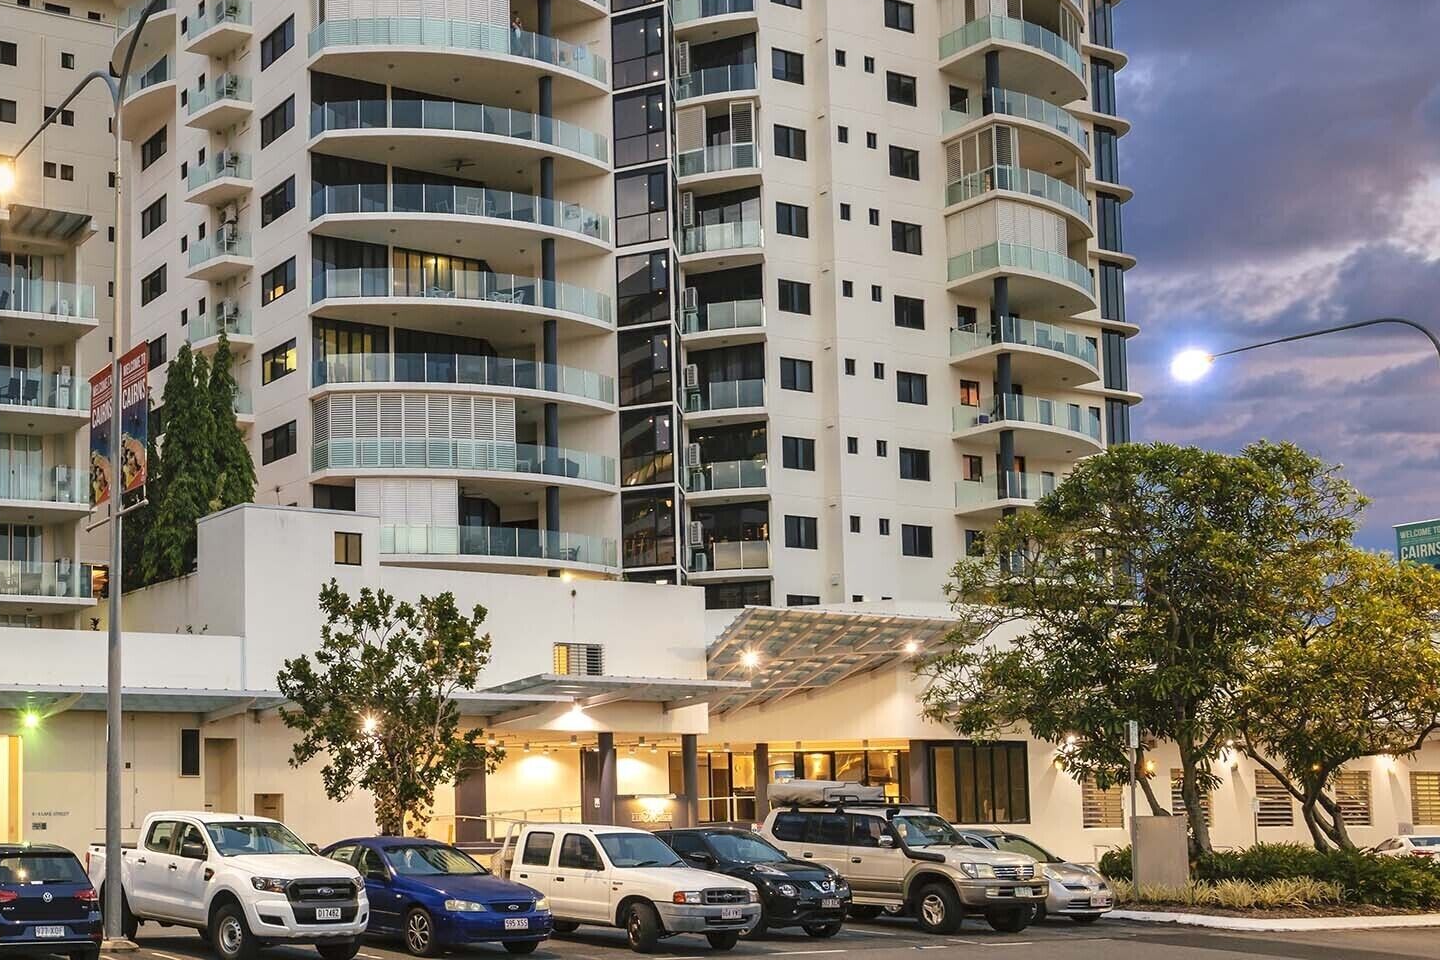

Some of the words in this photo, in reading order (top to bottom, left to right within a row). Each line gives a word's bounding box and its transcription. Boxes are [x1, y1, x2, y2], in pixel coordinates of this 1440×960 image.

[122, 378, 146, 409] CAIRNS
[1400, 527, 1432, 539] WELCOME
[1400, 541, 1440, 560] CAIRNS
